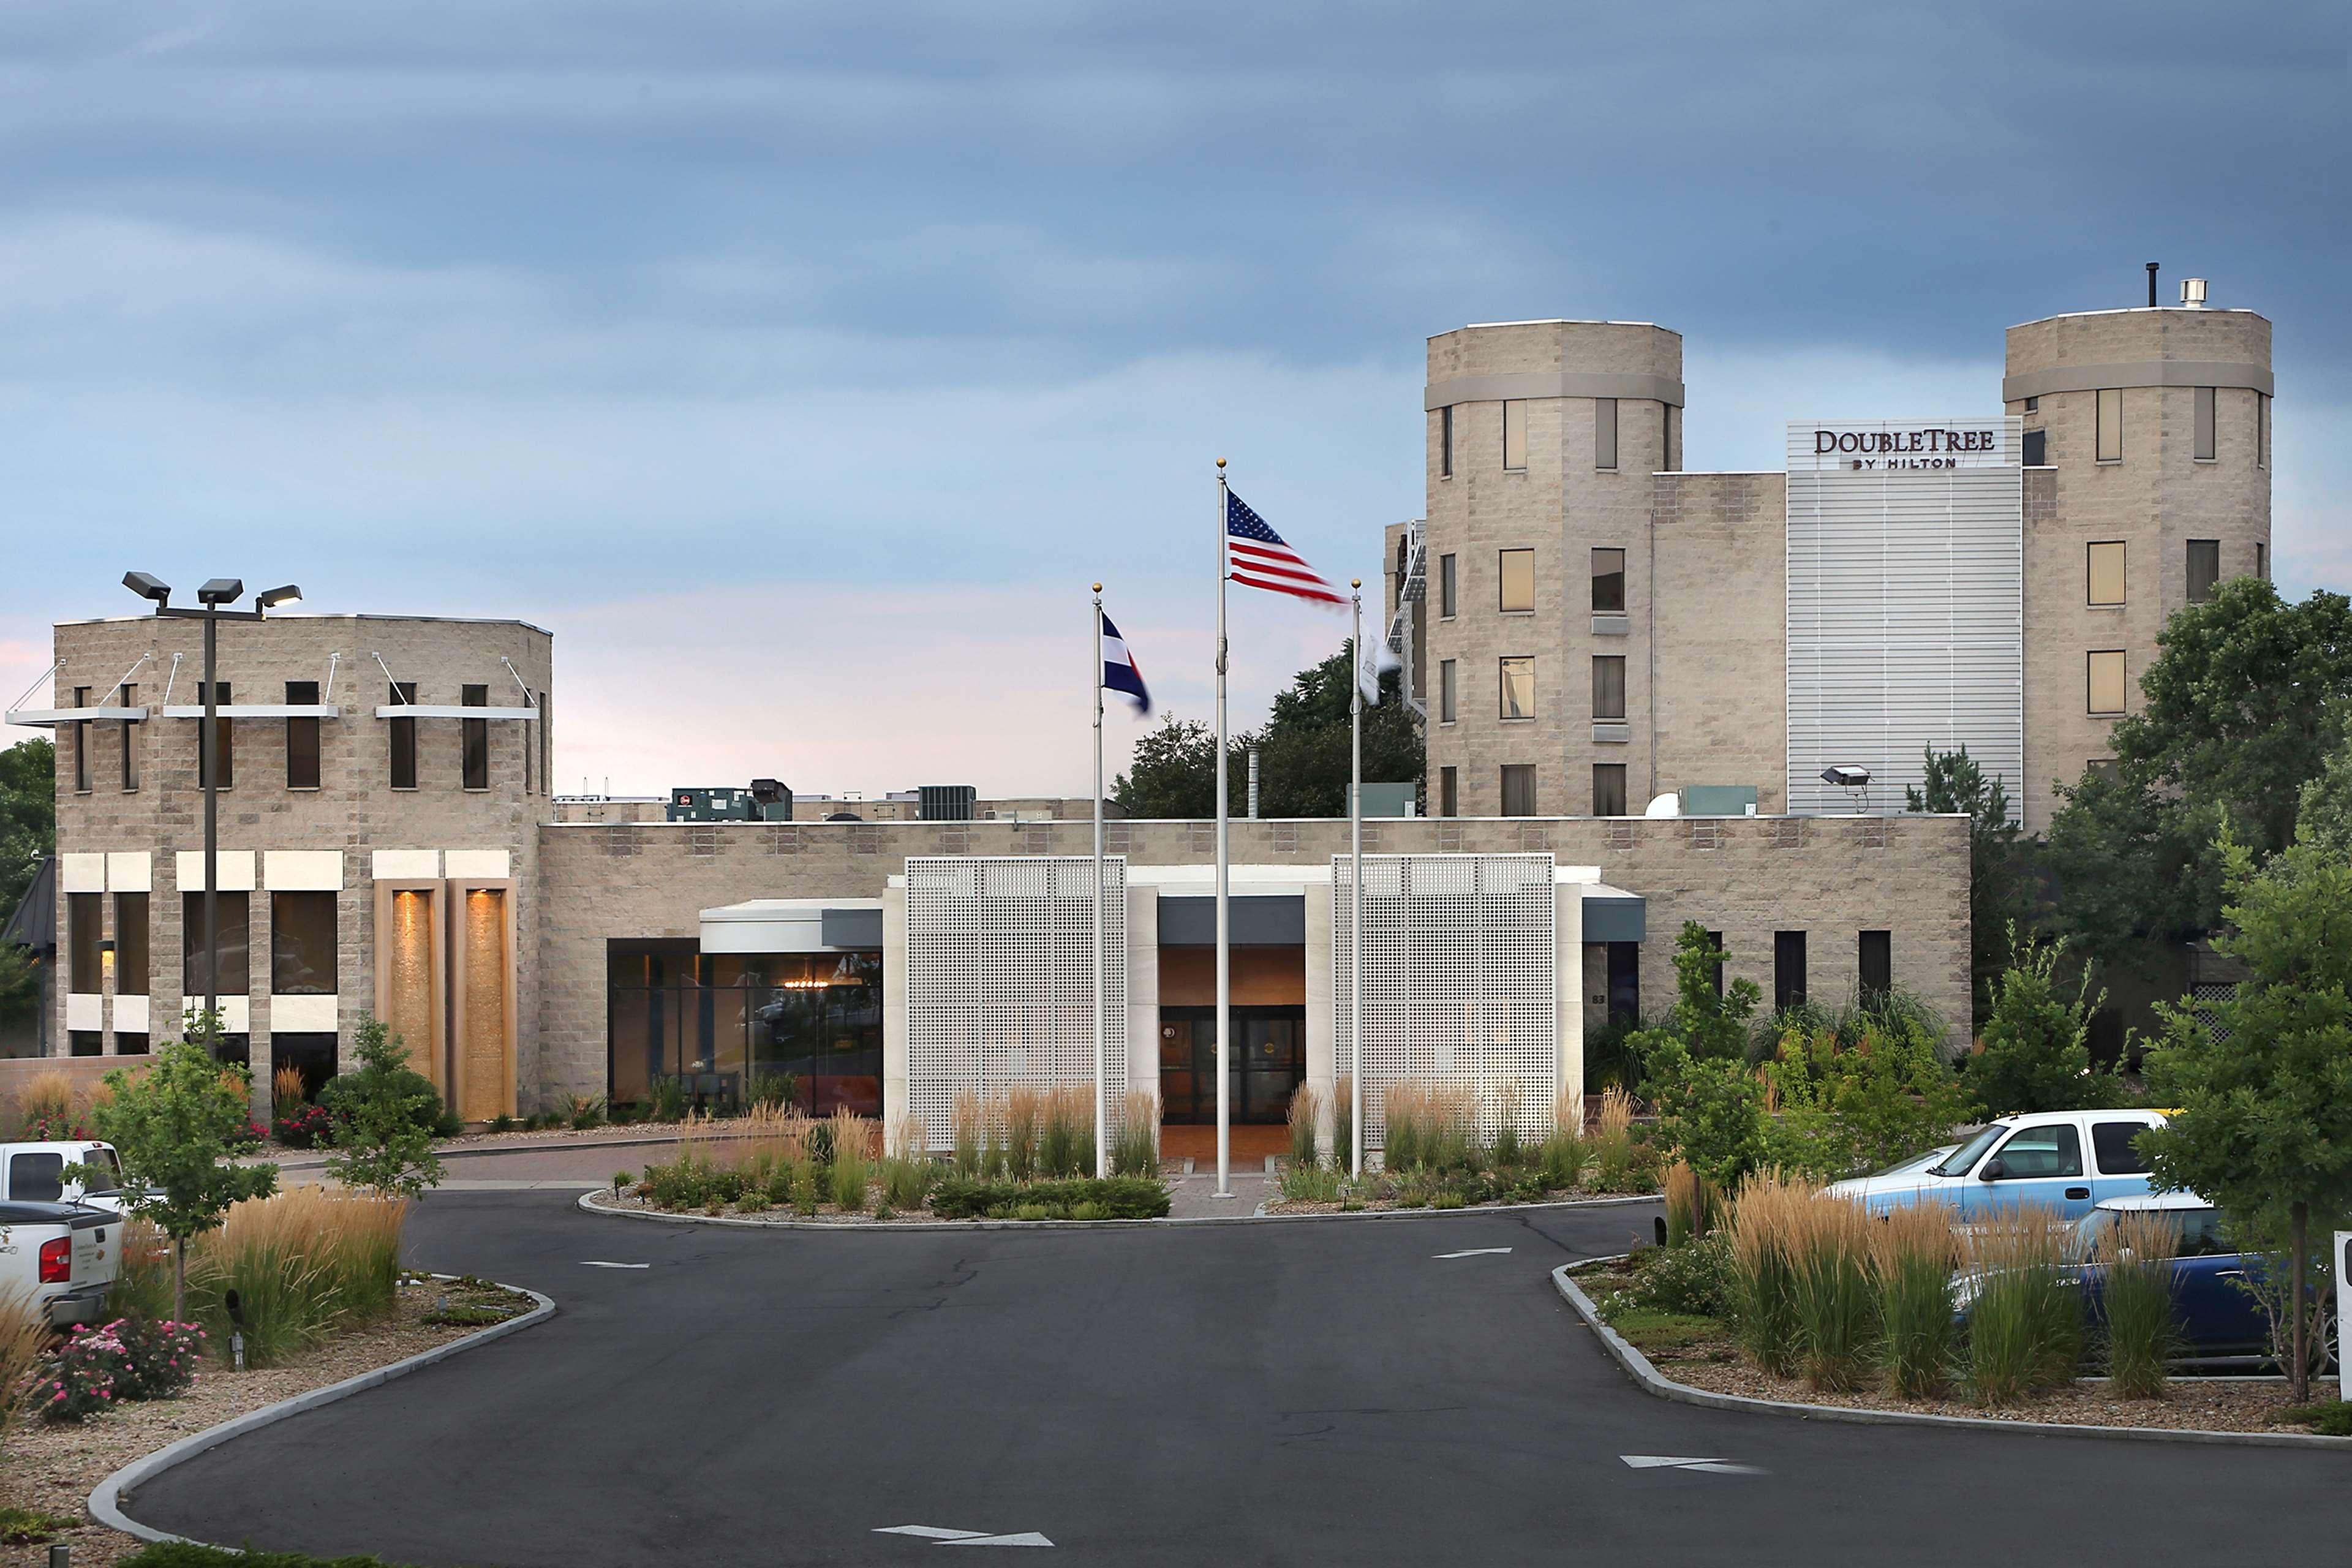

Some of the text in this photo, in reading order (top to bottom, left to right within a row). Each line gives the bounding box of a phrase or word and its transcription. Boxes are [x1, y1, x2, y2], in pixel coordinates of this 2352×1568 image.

[1853, 458, 1956, 470] BY HILTON
[1593, 995, 1605, 1004] 83
